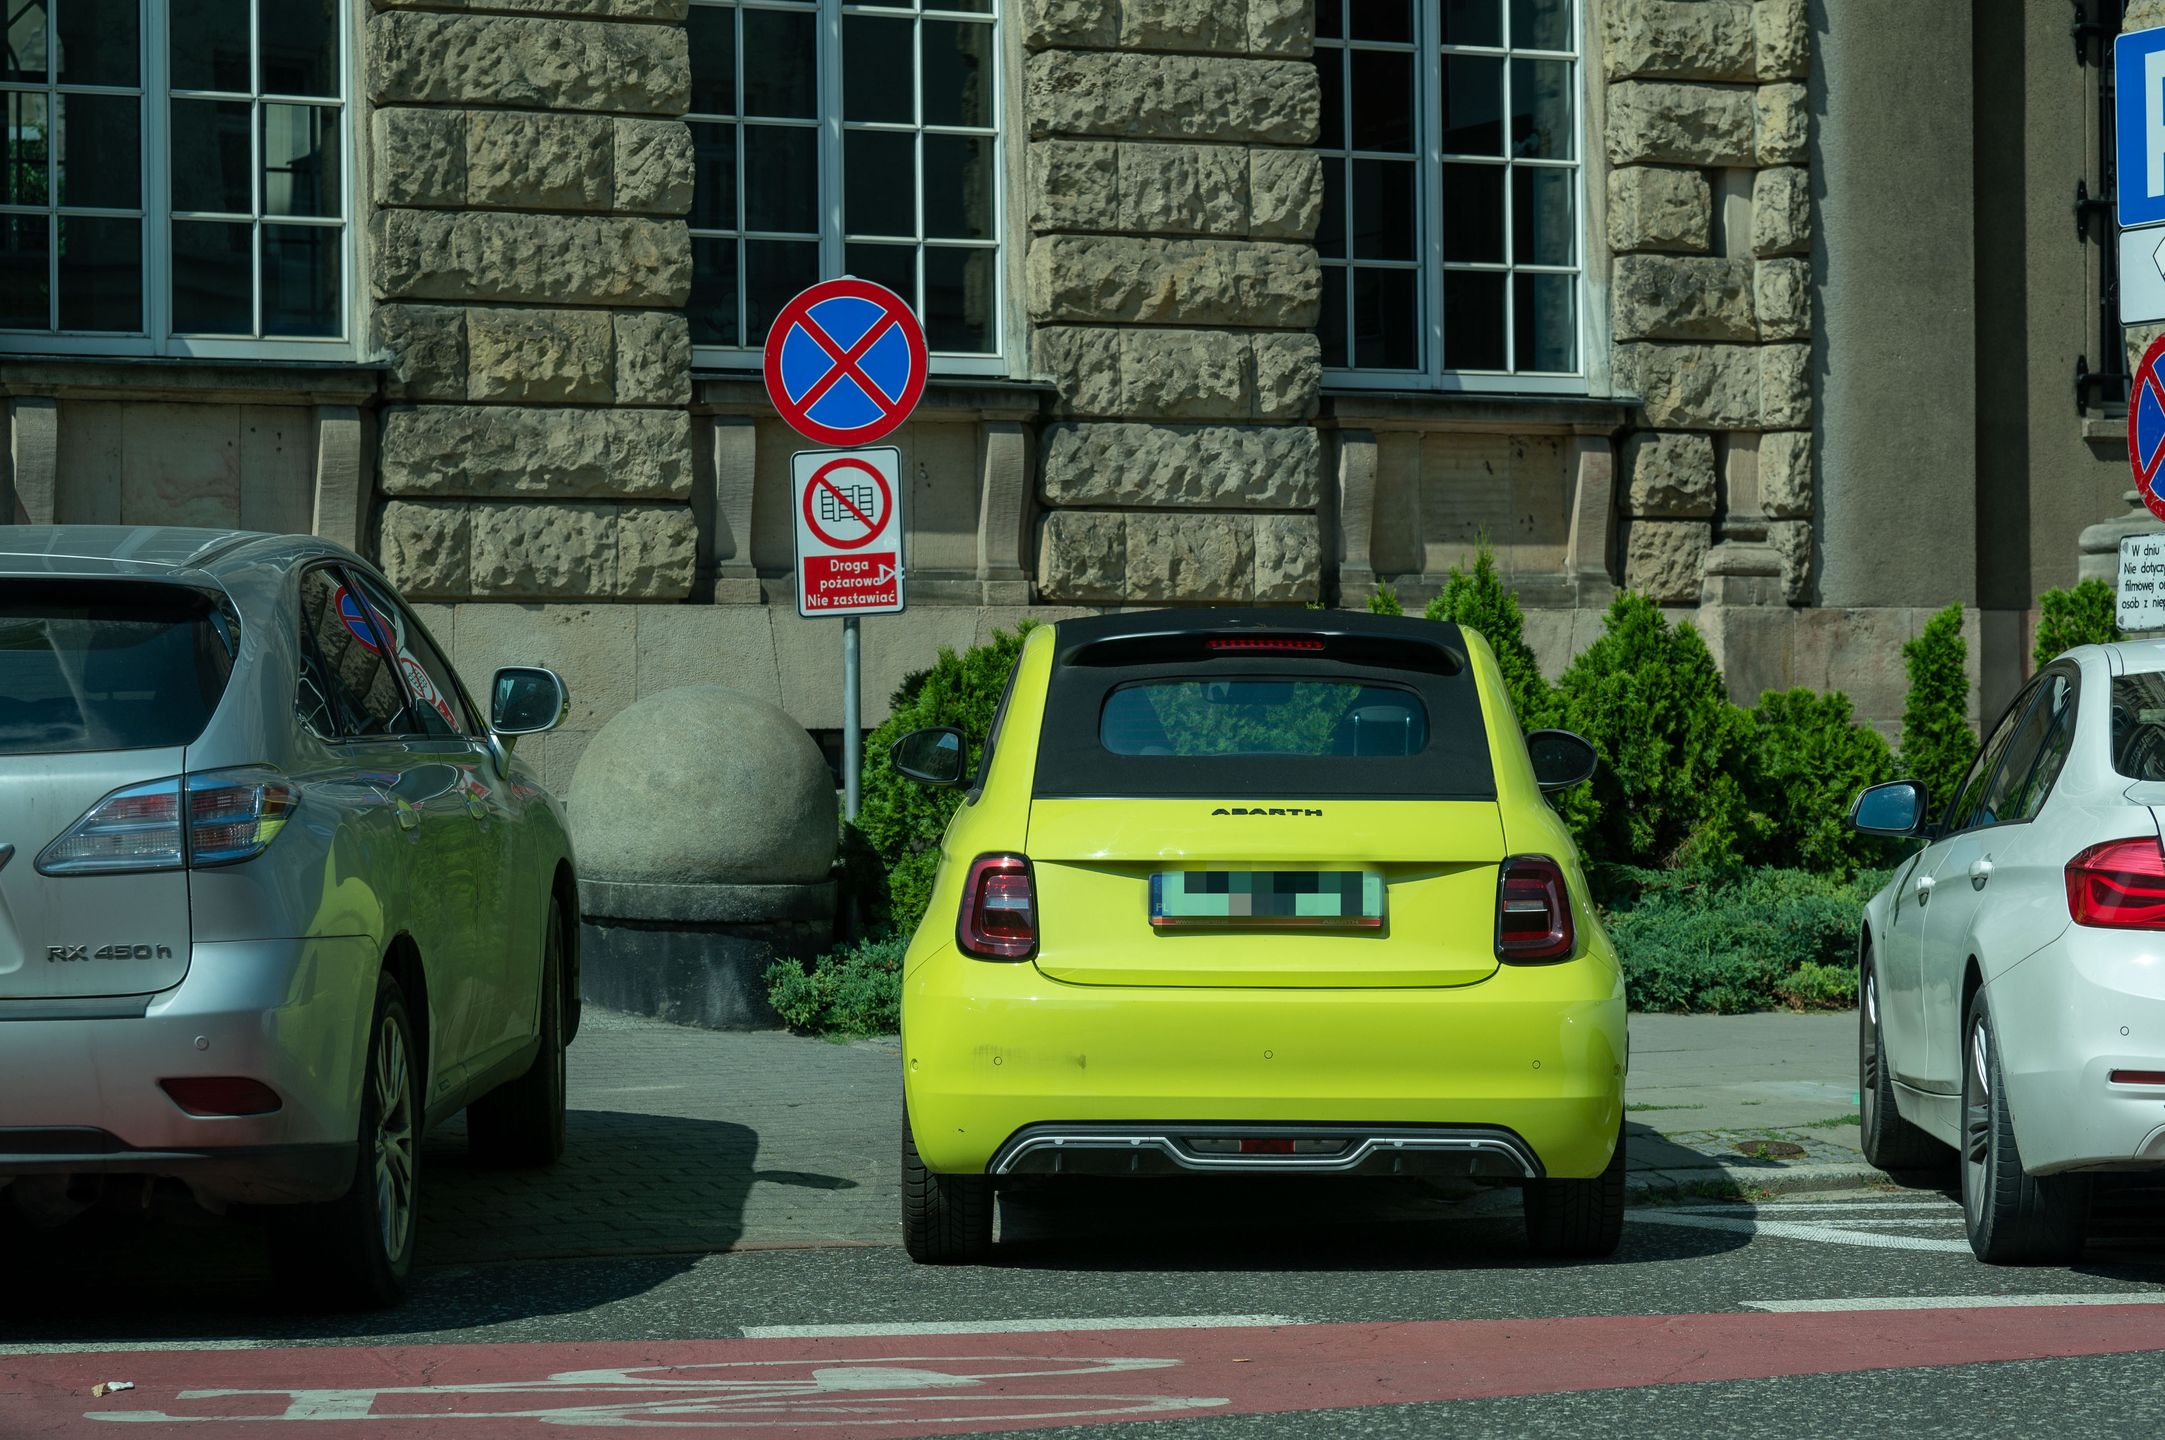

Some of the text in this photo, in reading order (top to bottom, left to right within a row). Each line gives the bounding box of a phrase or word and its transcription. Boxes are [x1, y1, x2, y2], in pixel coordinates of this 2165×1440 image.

[2132, 543, 2160, 557] W dniu
[830, 559, 869, 574] Droga
[2123, 562, 2137, 575] Nie
[820, 575, 881, 592] pożarowa
[2125, 578, 2155, 594] filmowej
[807, 590, 896, 607] Nie zastawiać
[2121, 596, 2140, 610] osób
[2144, 599, 2148, 608] z
[1211, 807, 1323, 817] ABARTH
[46, 944, 89, 962] RX
